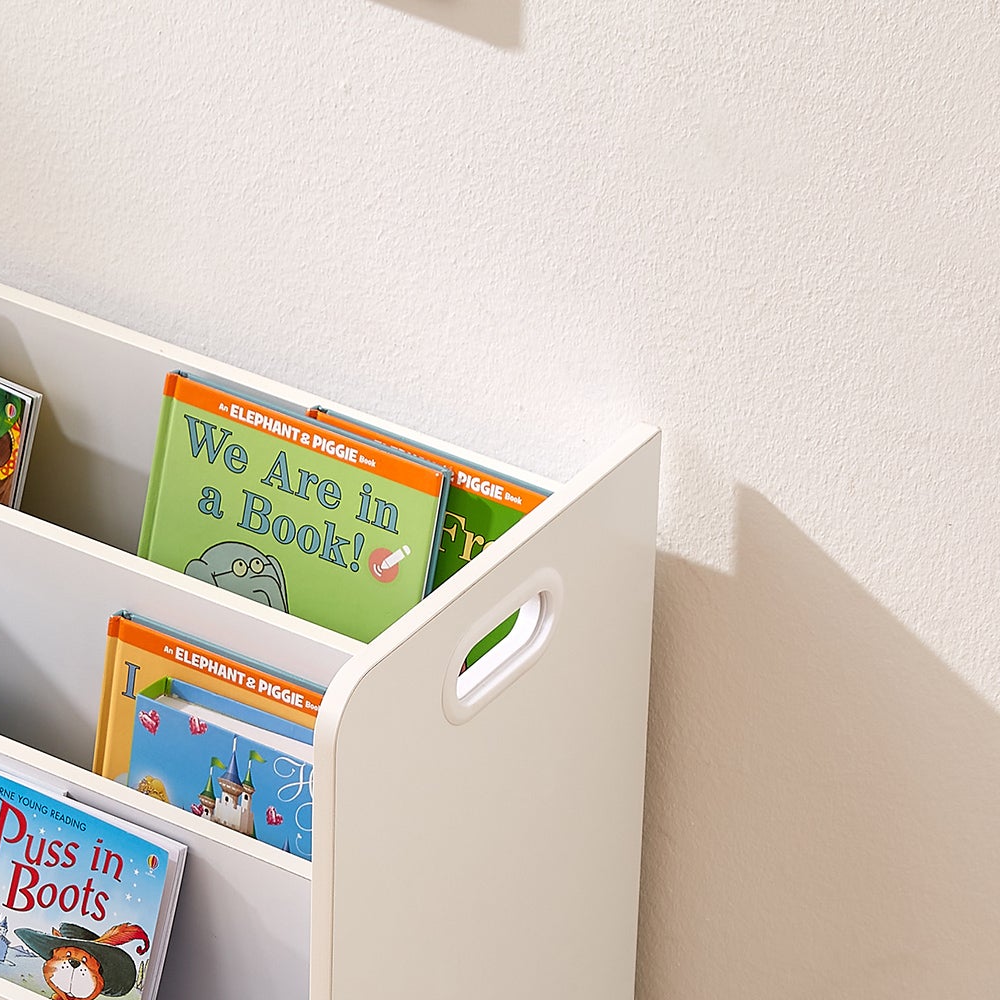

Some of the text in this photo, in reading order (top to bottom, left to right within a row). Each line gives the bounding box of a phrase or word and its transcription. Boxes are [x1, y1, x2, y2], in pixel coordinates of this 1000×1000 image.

[219, 403, 377, 468] An ELEPHANT & PIGGIE Book
[184, 415, 400, 535] We Are in
[457, 471, 505, 501] PIGGIE
[504, 492, 523, 506] Book
[198, 486, 366, 573] a Book!
[439, 512, 496, 562] Fr
[122, 661, 141, 700] I
[164, 645, 319, 711] An ELEPHANT & PIGGIE Boo
[18, 793, 49, 817] YOUNG
[50, 805, 87, 833] READING
[91, 838, 124, 884] in
[2, 860, 110, 923] Boots
